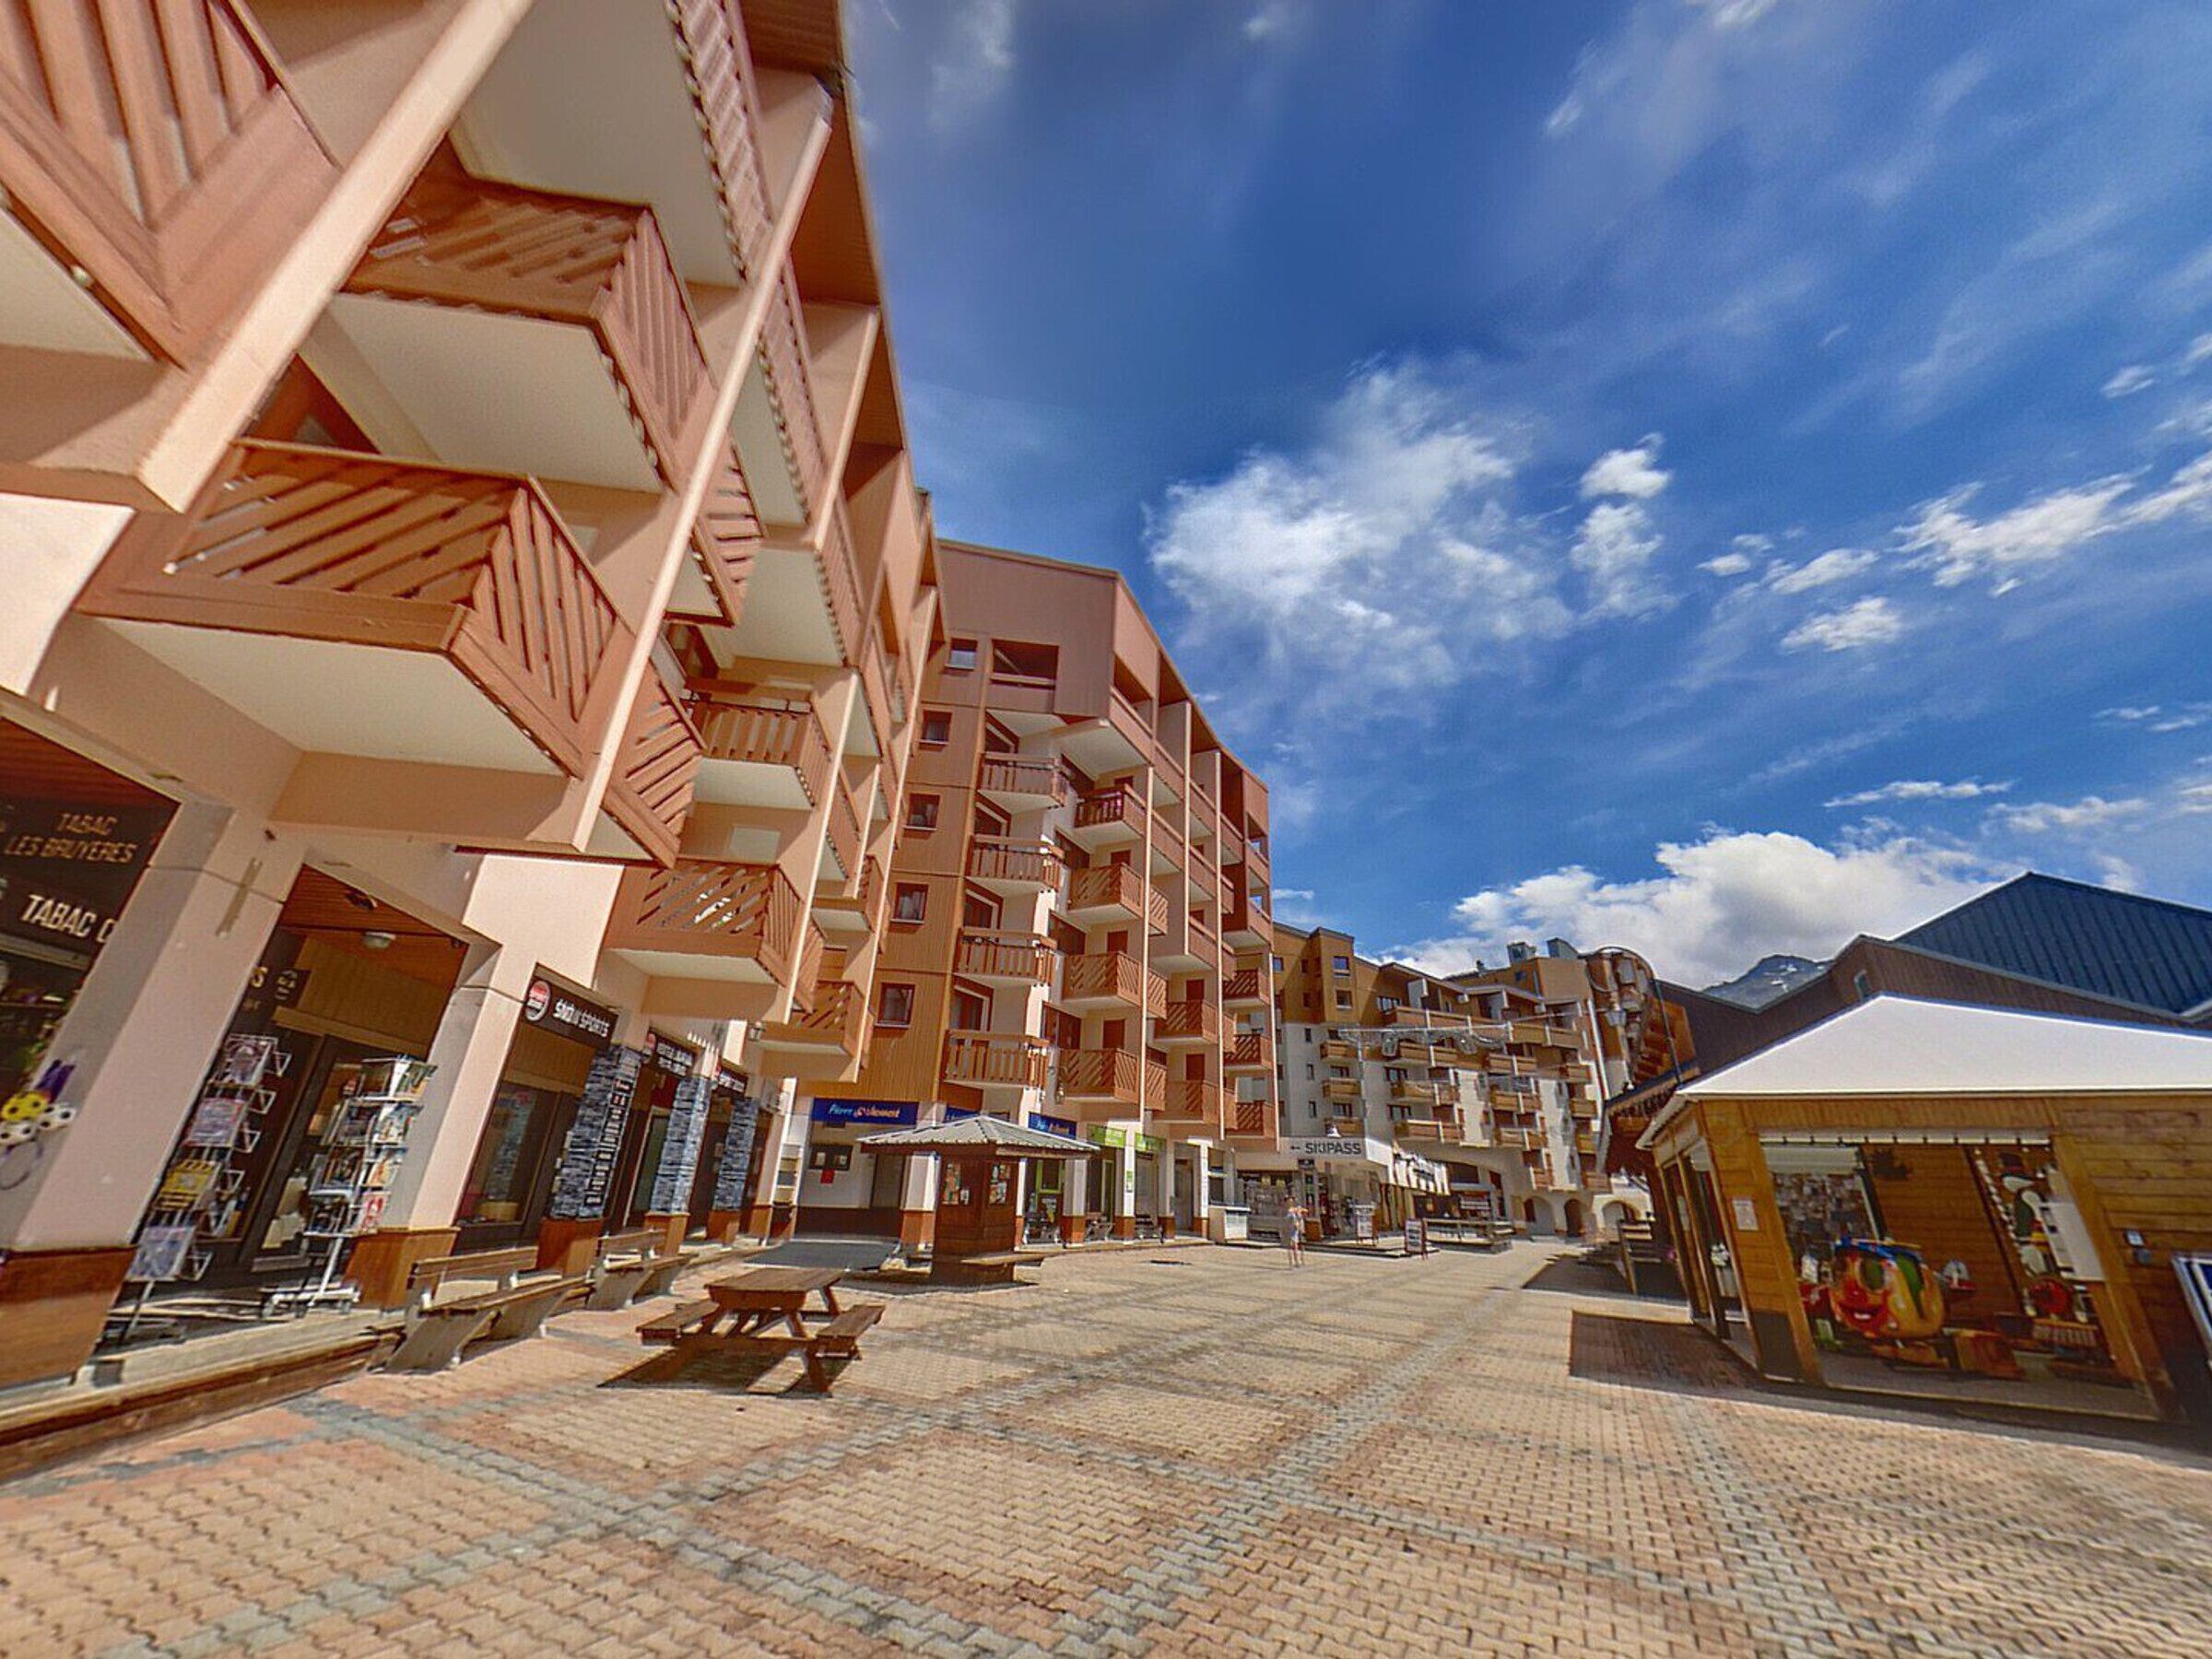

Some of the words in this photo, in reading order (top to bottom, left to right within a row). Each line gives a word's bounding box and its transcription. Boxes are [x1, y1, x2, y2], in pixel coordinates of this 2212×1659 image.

[57, 813, 118, 836] TABAC
[4, 836, 45, 856] LES
[20, 894, 97, 938] TABAC
[1305, 1142, 1362, 1155] SKIPASS
